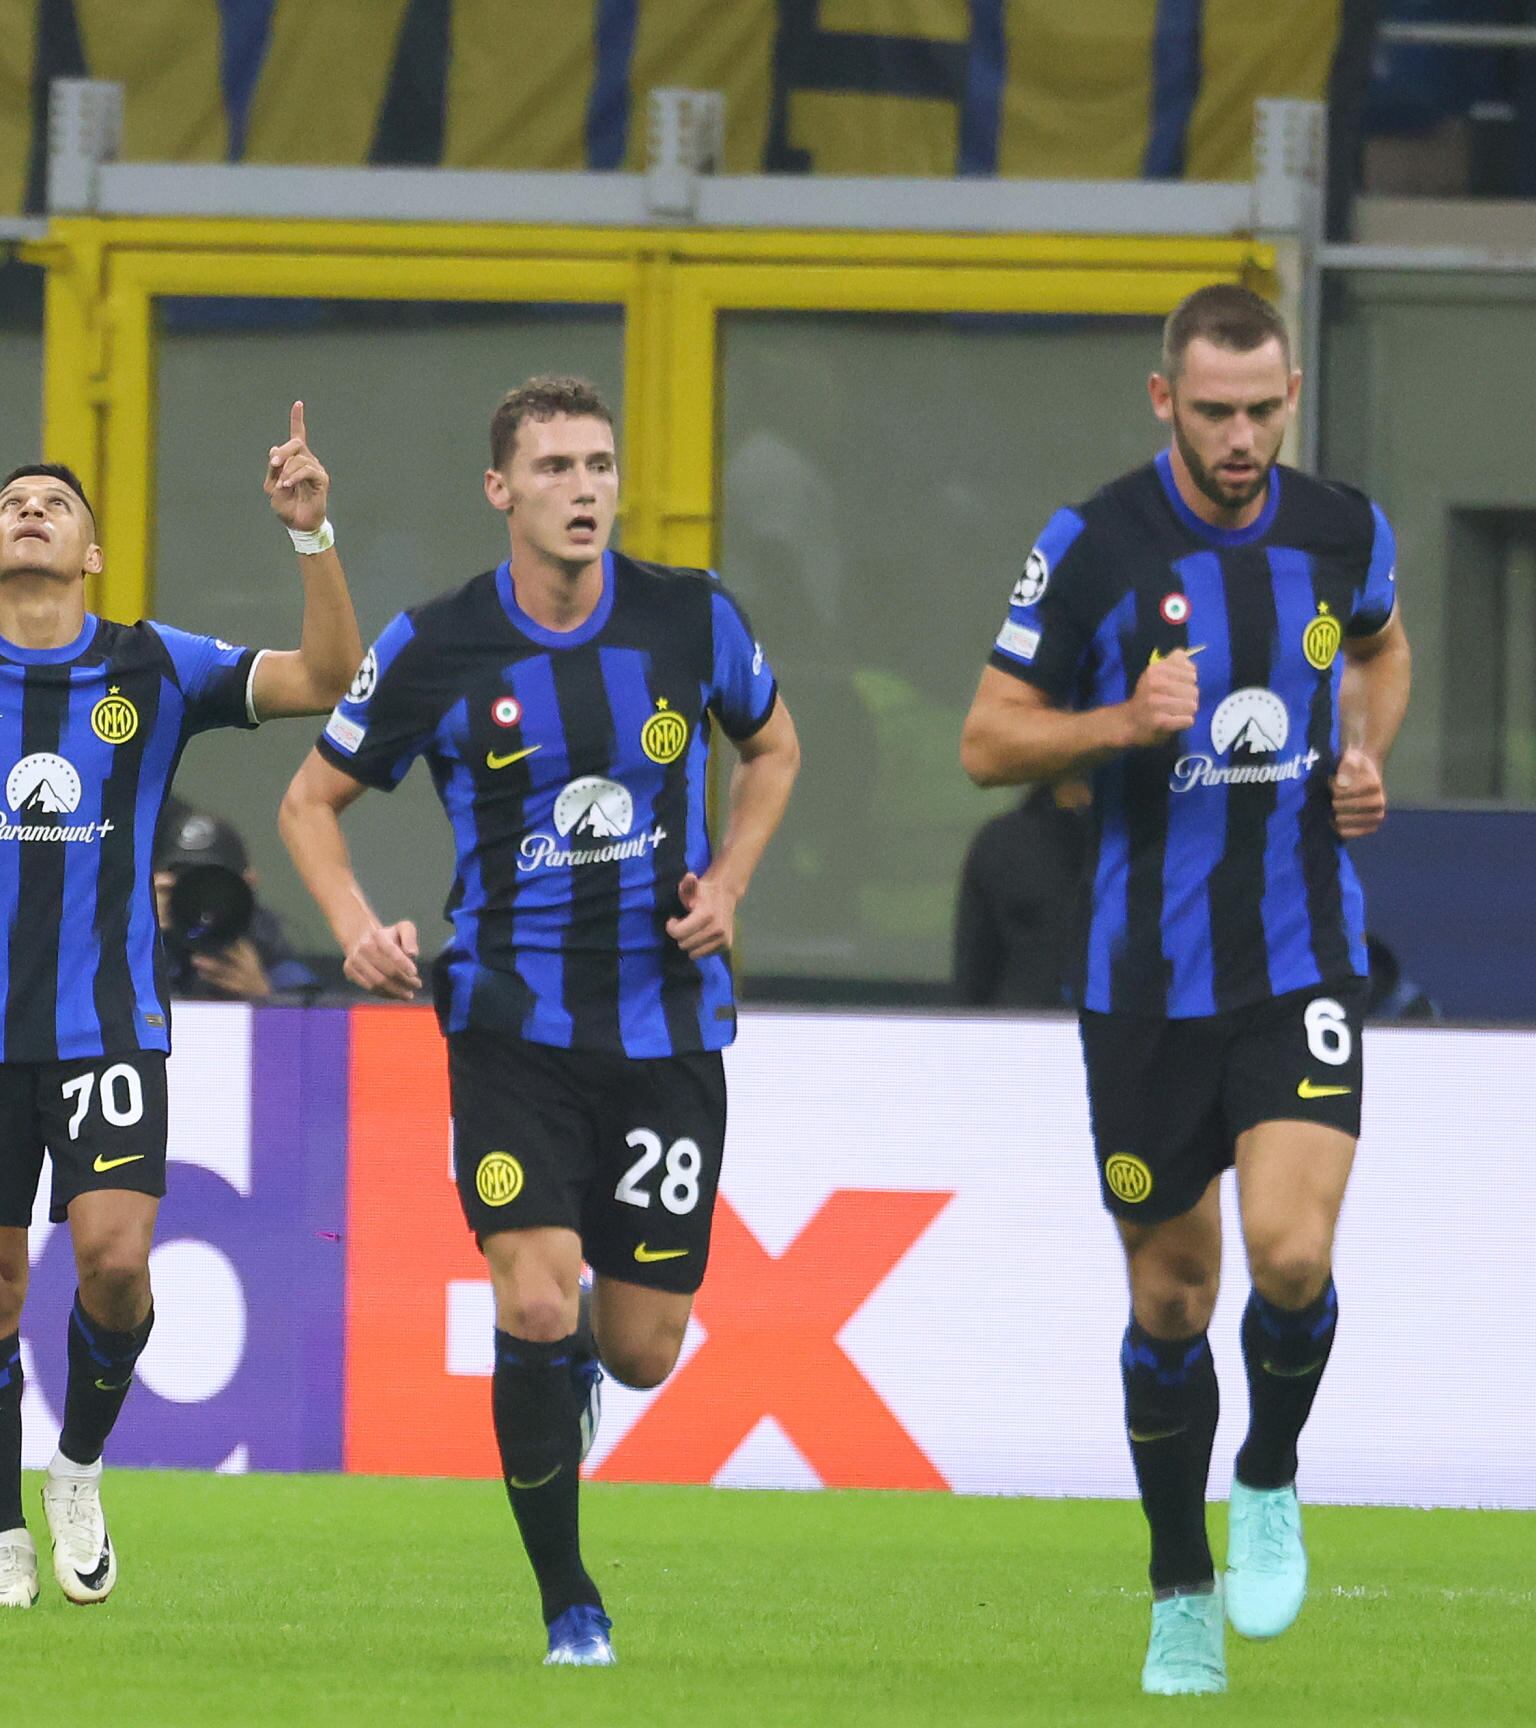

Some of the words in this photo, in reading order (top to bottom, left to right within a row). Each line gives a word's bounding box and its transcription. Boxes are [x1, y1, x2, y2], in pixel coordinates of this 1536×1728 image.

[1169, 749, 1320, 793] Paramount+
[517, 826, 667, 872] Paramount+
[1303, 997, 1353, 1066] 6
[61, 1062, 144, 1141] 70
[614, 1127, 703, 1215] 28
